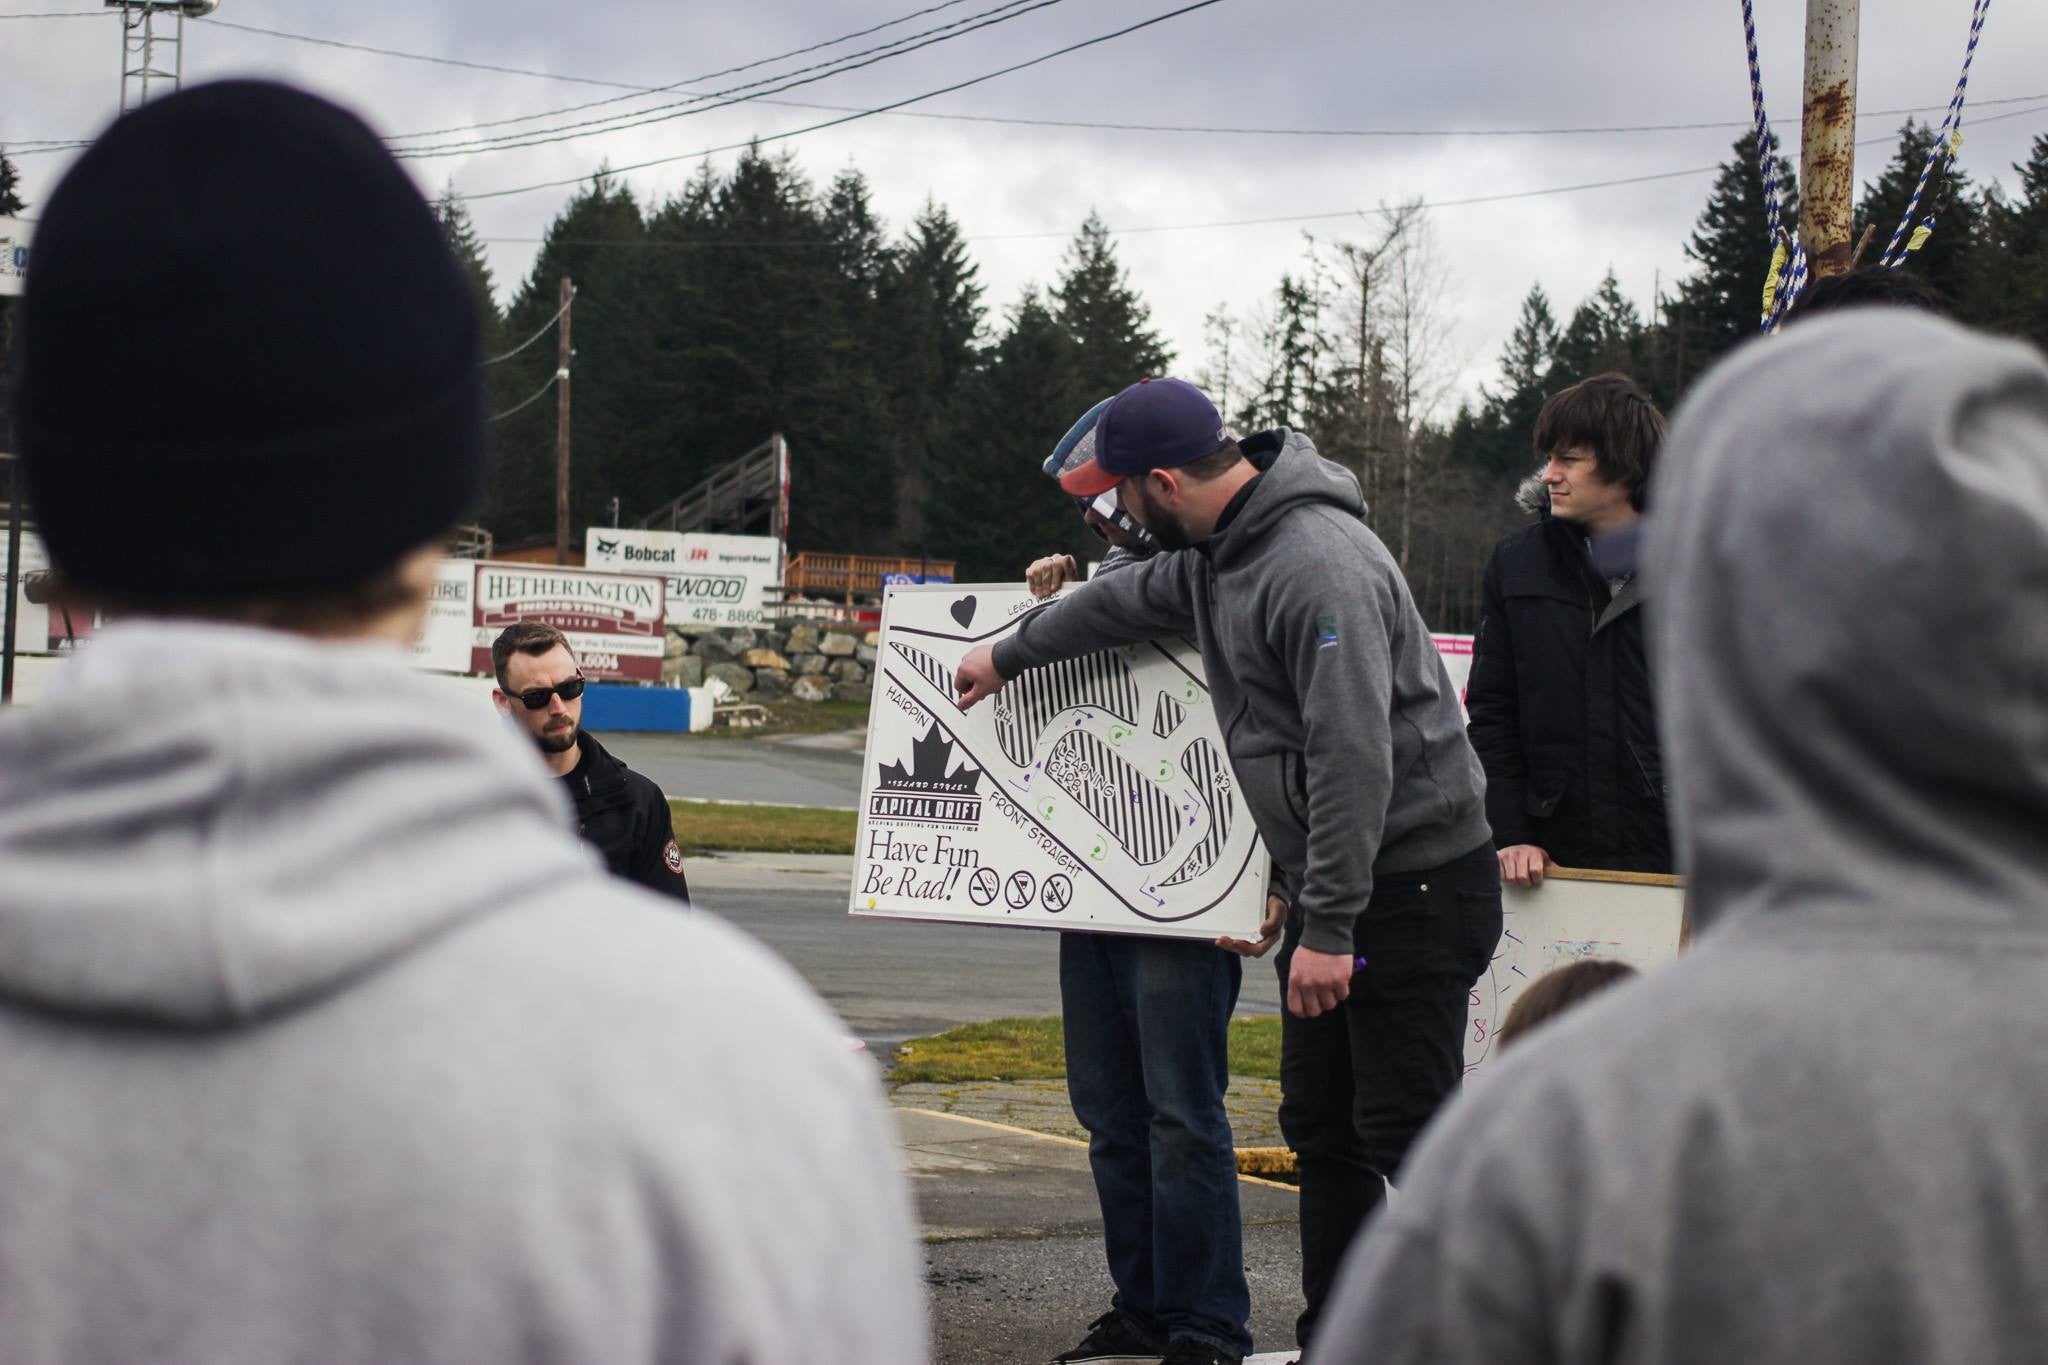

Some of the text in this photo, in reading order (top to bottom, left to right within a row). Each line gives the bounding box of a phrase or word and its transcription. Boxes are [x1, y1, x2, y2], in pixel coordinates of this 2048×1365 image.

[624, 545, 676, 562] Bobcat
[488, 575, 655, 607] HETHERINGTON
[516, 601, 625, 619] INDUSTRIES
[1008, 598, 1034, 616] LEGO
[540, 616, 600, 628] LIMITED
[886, 685, 930, 727] HAIRPIN
[995, 704, 1013, 725] #4
[1049, 761, 1082, 792] CURB
[1056, 743, 1116, 798] LEARNING
[1215, 772, 1231, 792] #2
[871, 796, 980, 820] CAPITAL DRIFT
[988, 791, 1084, 877] FRONT STRAIGHT
[867, 829, 980, 869] Have Fun
[860, 864, 962, 901] Be Rad!
